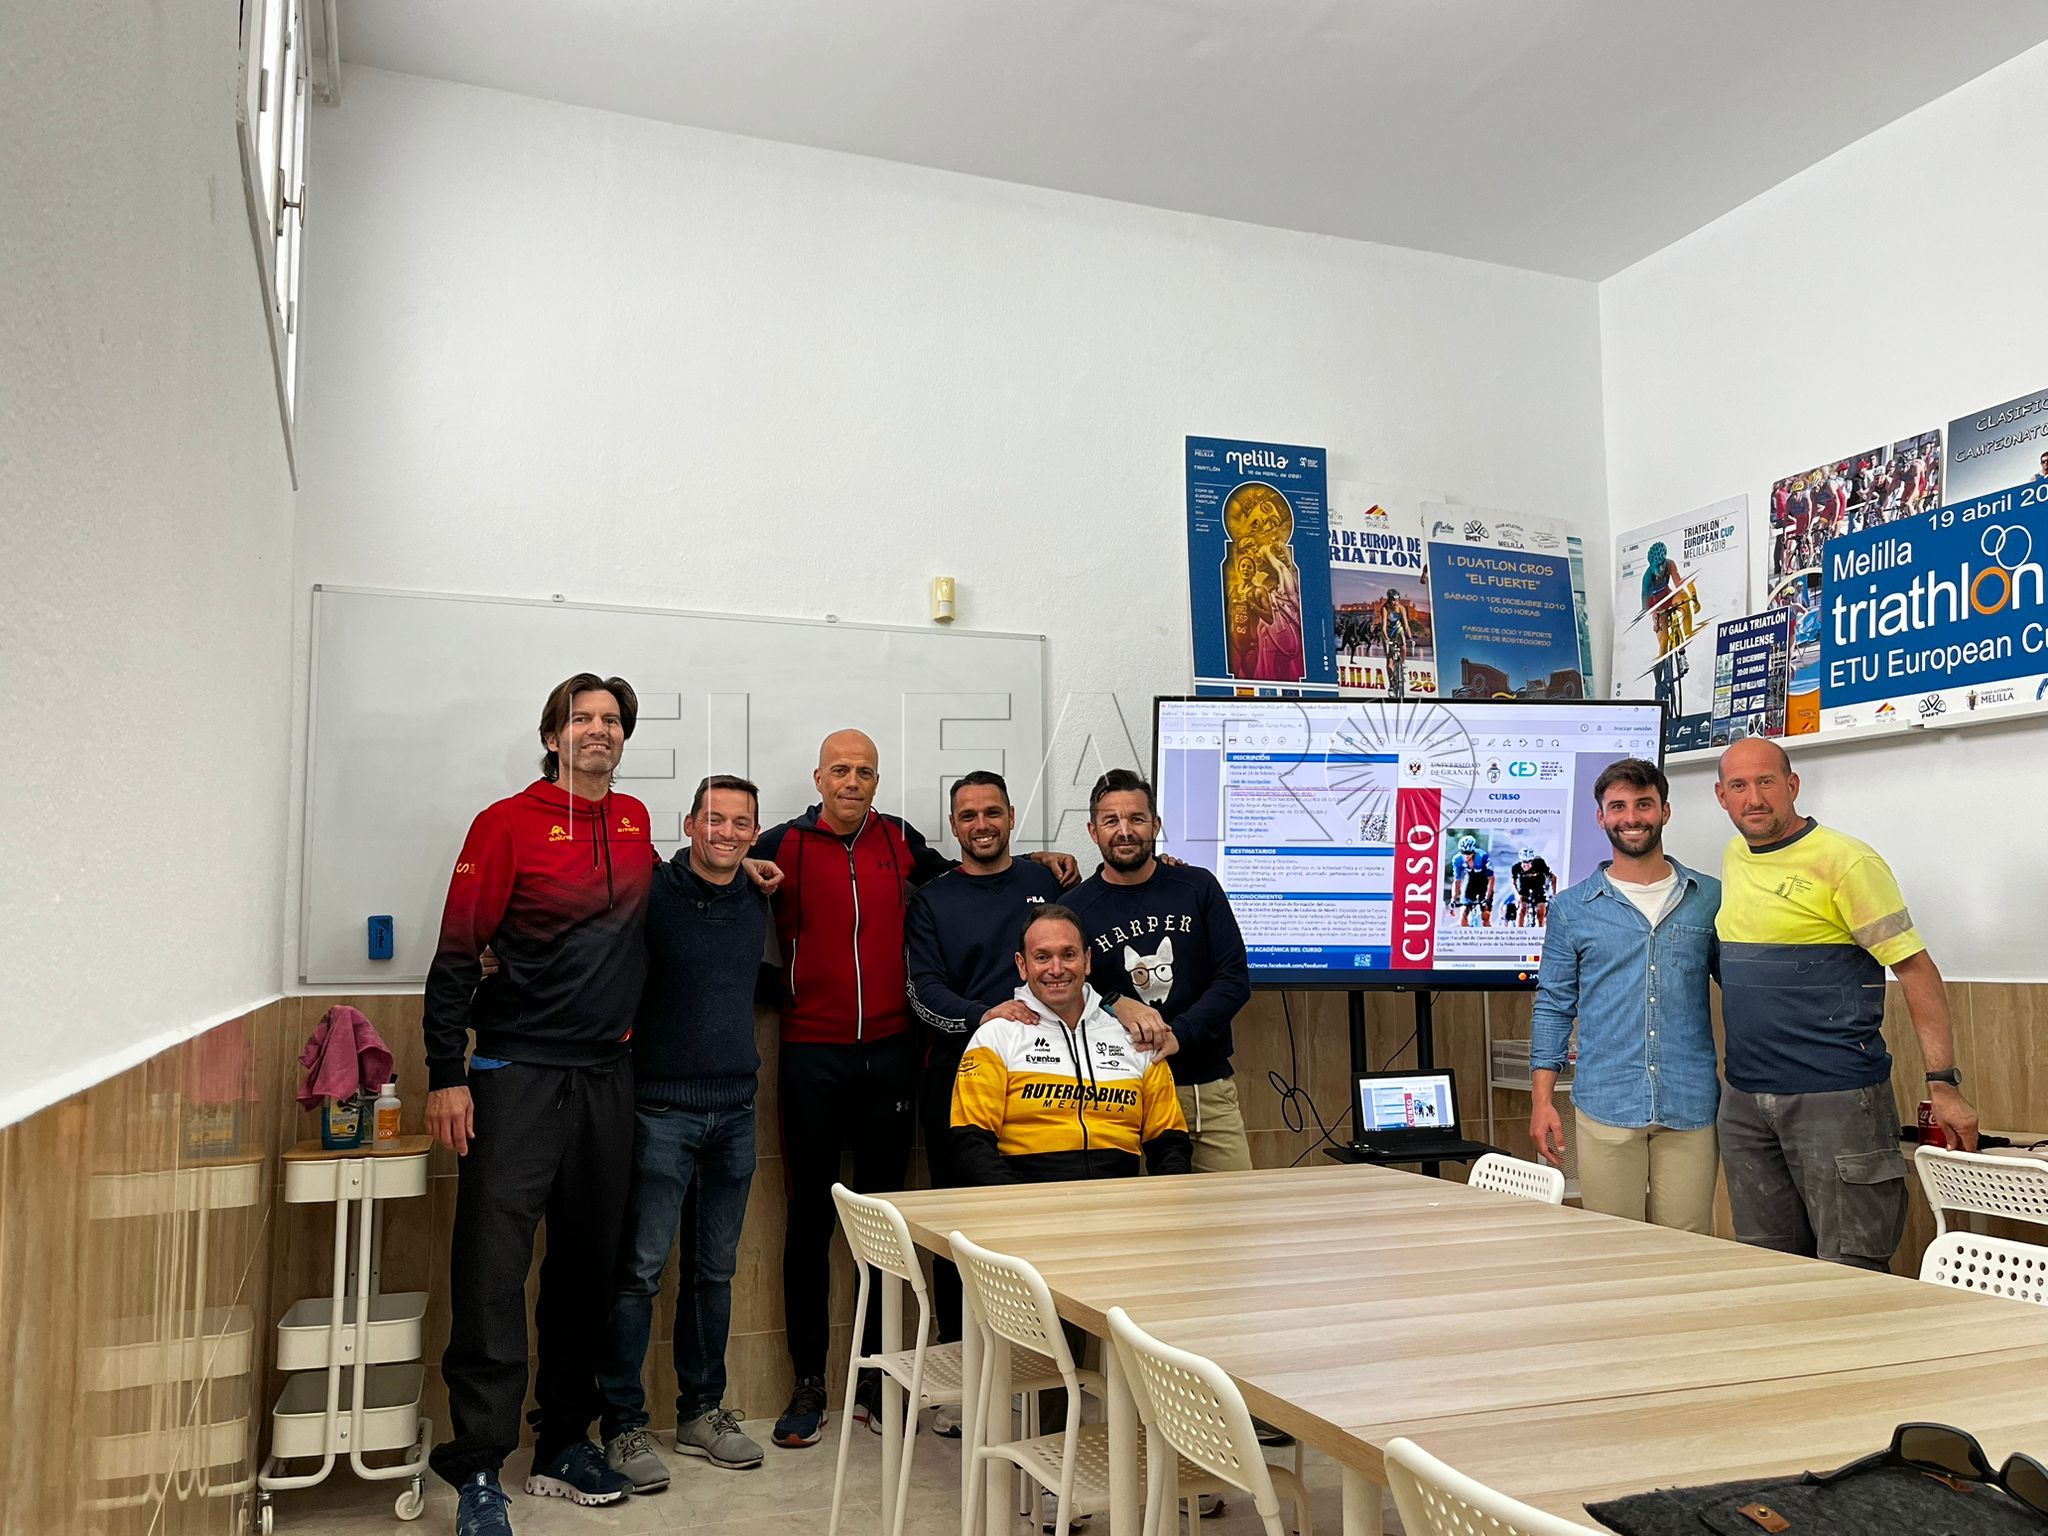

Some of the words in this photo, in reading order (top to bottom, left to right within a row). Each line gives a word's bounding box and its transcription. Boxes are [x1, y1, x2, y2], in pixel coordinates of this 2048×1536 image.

[1226, 450, 1288, 475] melilla
[1929, 510, 1954, 530] 19
[1962, 493, 2011, 522] abril
[1684, 519, 1720, 538] TRIATHLON
[1684, 530, 1719, 549] EUROPEAN
[1720, 525, 1735, 538] CUP
[1342, 530, 1357, 546] DE
[1360, 532, 1404, 551] EUROPA
[1407, 537, 1421, 553] DE
[1498, 541, 1524, 549] MELILLA
[1684, 547, 1710, 559] MELILLA
[1710, 539, 1726, 552] 2018
[1457, 557, 1517, 572] DUATLON
[1519, 564, 1553, 576] CROS
[1833, 538, 1913, 582] Melilla
[1502, 598, 1542, 608] DICIEMBRE
[1544, 602, 1566, 610] 2010
[1514, 608, 1541, 617] HORAS
[1832, 561, 2044, 646] triathlon
[1523, 630, 1552, 639] DEPORTE
[1719, 627, 1727, 638] IV
[1728, 623, 1748, 636] GALA
[1750, 612, 1786, 629] TRIATLÓN
[1729, 633, 1775, 652] MELILLENSE
[1749, 664, 1765, 674] HORAS
[1830, 653, 1879, 688] ETU
[1888, 636, 2012, 679] European
[1408, 671, 1418, 680] 19
[1420, 672, 1431, 681] DE
[1981, 692, 2014, 704] MELILLA
[1233, 753, 1271, 761] INSCRIPCIÓN
[1402, 824, 1434, 961] CURSO
[1095, 914, 1192, 953] HARPER
[1026, 1055, 1061, 1063] Eventos
[1021, 1083, 1095, 1101] RUTEROS
[1099, 1088, 1137, 1106] BIKES
[1042, 1100, 1125, 1113] MELILLA
